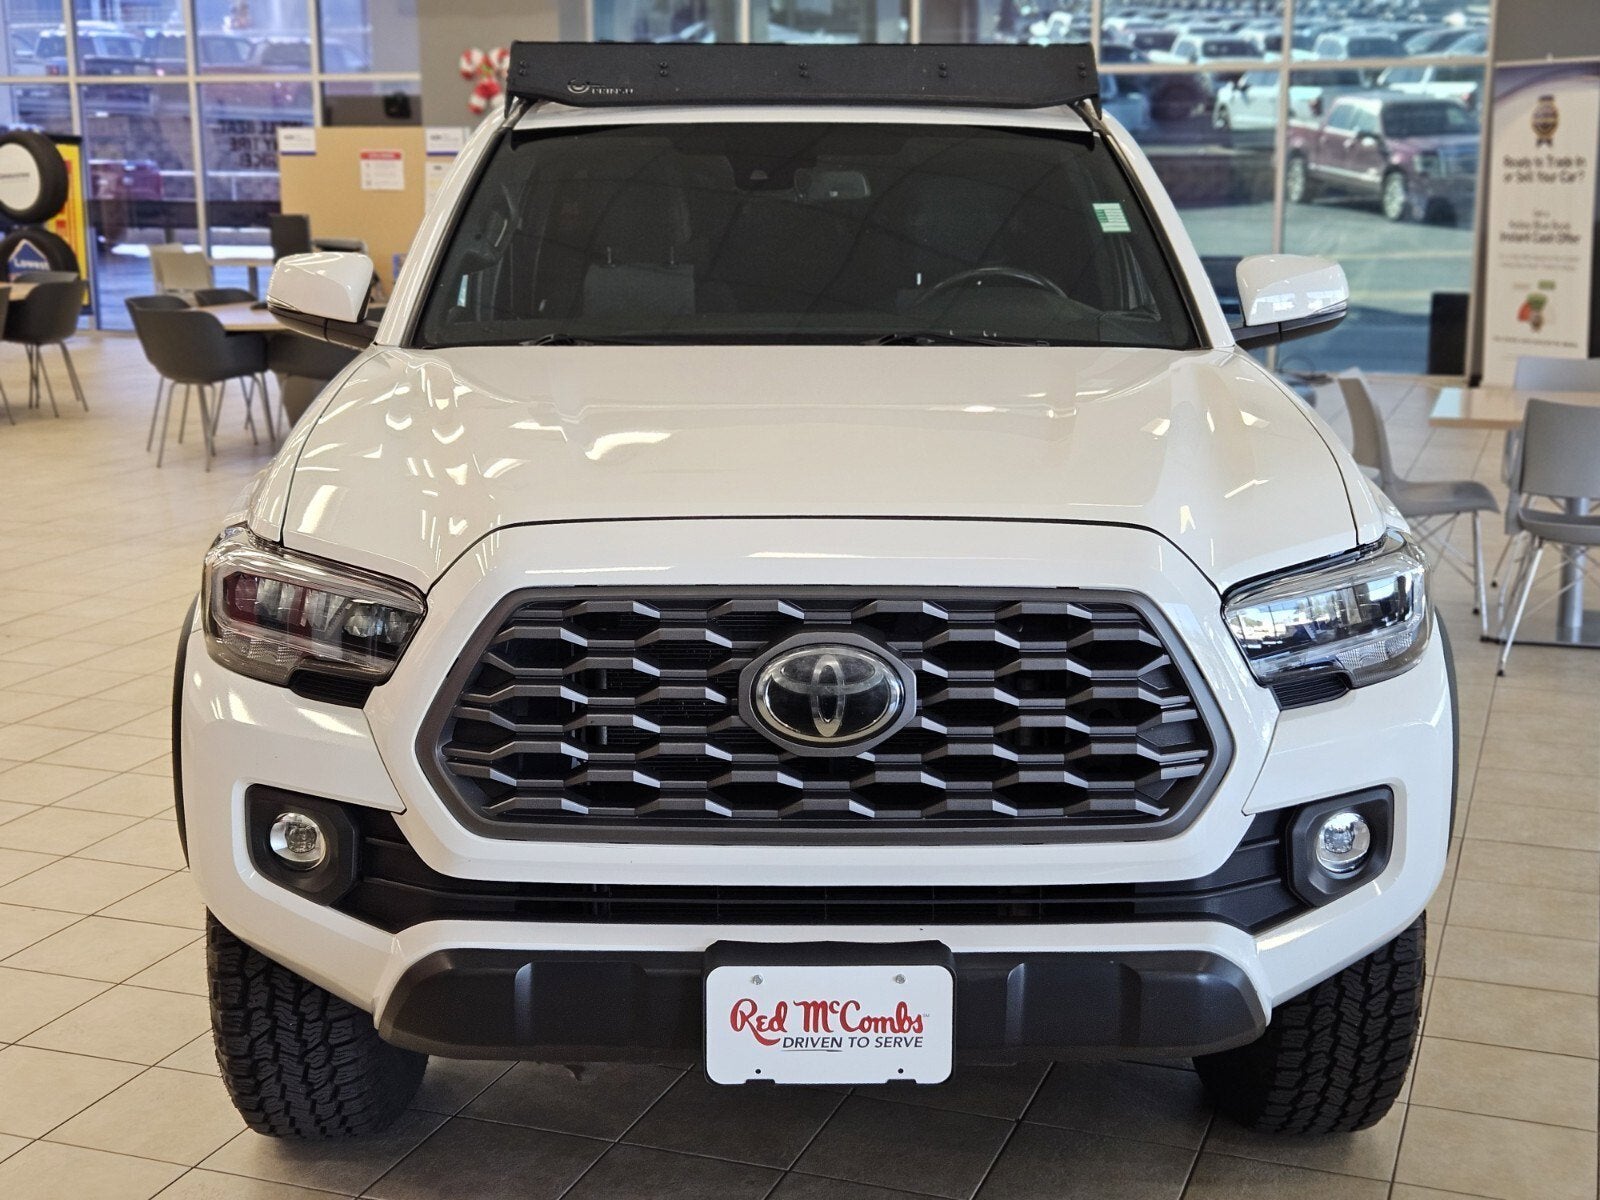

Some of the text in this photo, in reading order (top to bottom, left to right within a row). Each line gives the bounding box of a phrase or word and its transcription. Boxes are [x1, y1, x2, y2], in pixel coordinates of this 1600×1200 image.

[730, 998, 924, 1046] Red McCombs
[782, 1036, 924, 1049] DRIVEN TO SERVE
